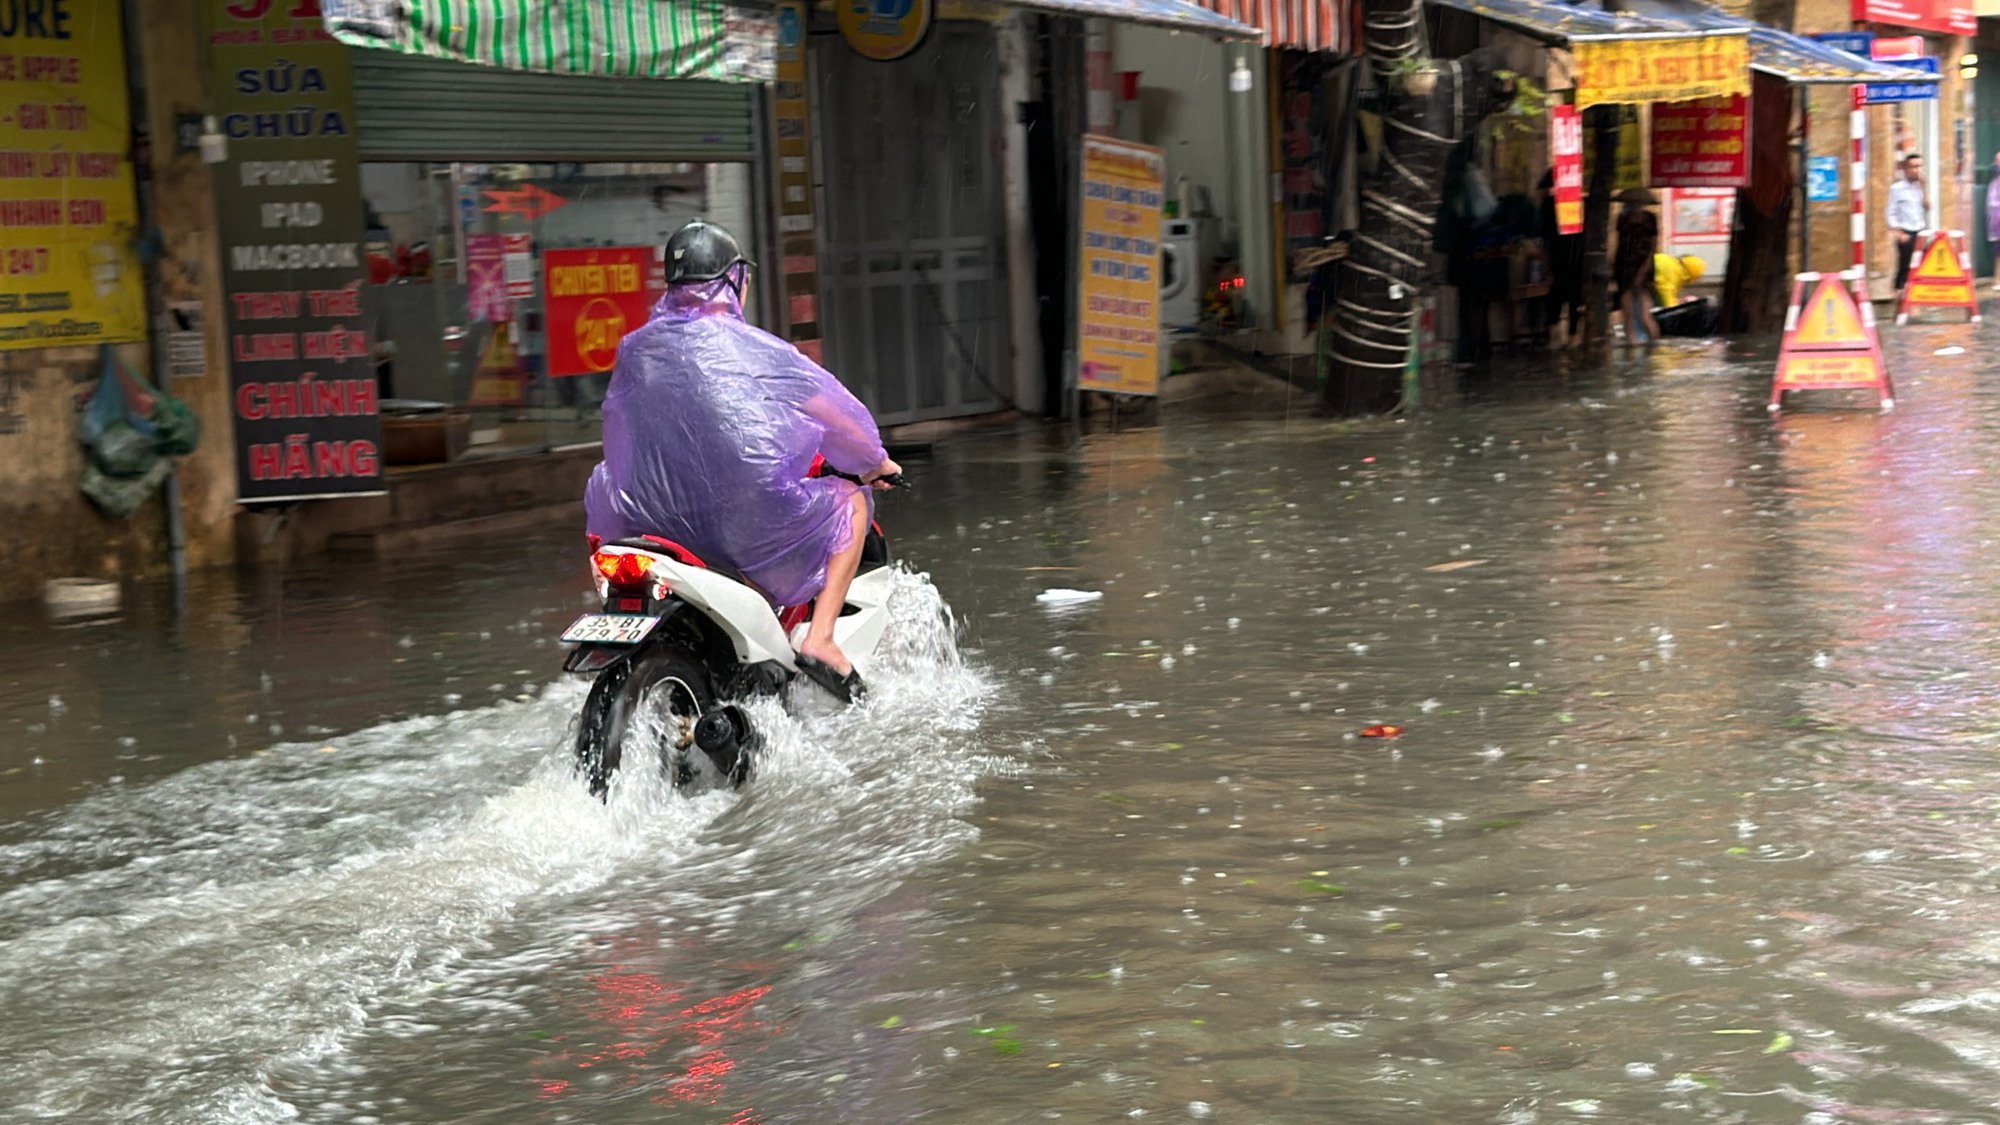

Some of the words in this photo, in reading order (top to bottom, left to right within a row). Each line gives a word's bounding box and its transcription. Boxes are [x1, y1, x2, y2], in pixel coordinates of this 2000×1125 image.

[235, 58, 326, 94] SỬA
[224, 106, 347, 139] CHỮA
[240, 159, 337, 187] IPHONE
[261, 202, 323, 228] IPAD
[231, 243, 359, 271] MACBOOK
[233, 291, 299, 320] THAY
[307, 279, 365, 317] THẾ
[303, 324, 369, 364] KIỆN
[236, 372, 378, 419] CHÍNH
[248, 433, 379, 481] HÃNG
